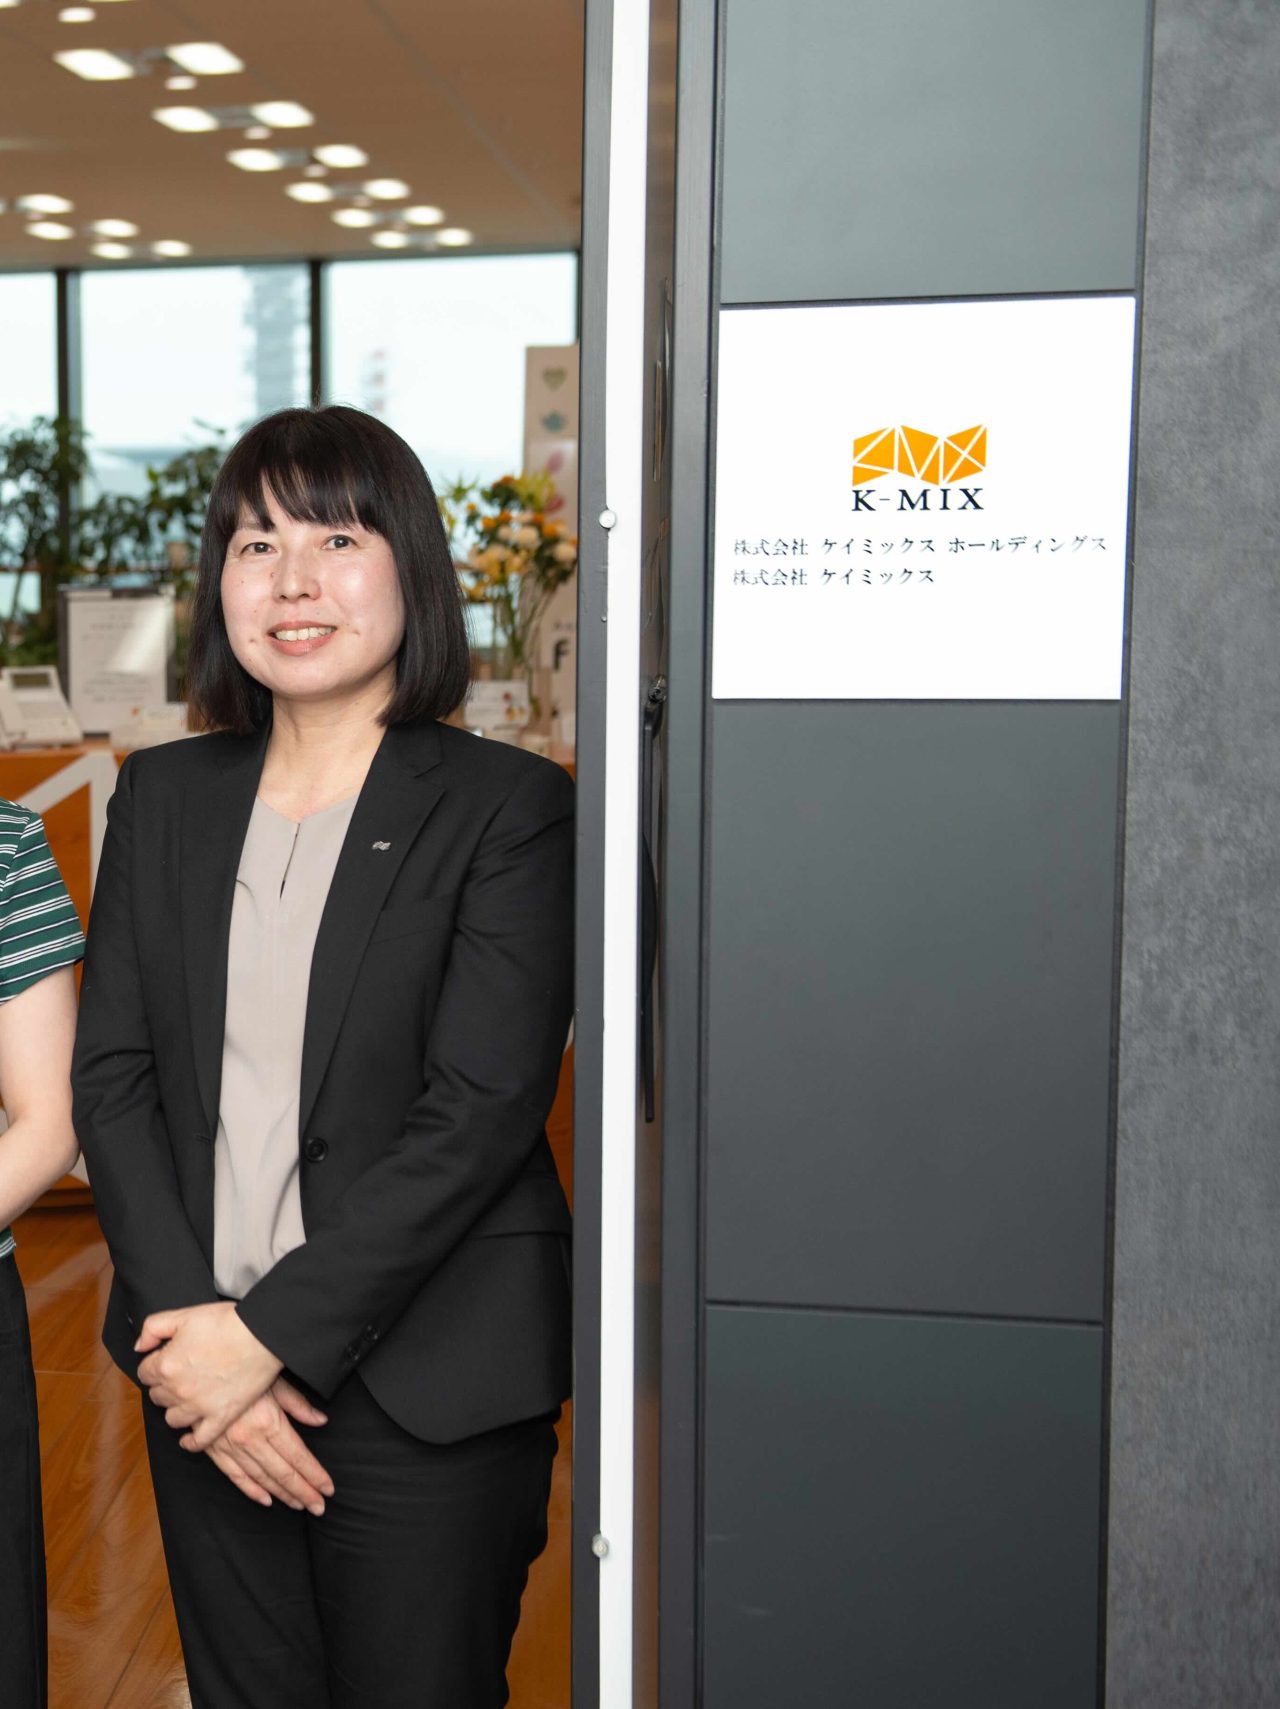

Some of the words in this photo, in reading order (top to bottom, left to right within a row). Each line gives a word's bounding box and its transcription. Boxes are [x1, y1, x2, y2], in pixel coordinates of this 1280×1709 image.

[851, 487, 984, 512] K-MIX
[733, 537, 809, 556] 株式会社
[821, 536, 936, 555] ケイミックス
[947, 534, 1108, 554] ホールディングス
[732, 567, 808, 586] 株式会社
[821, 566, 935, 585] ケイミックス
